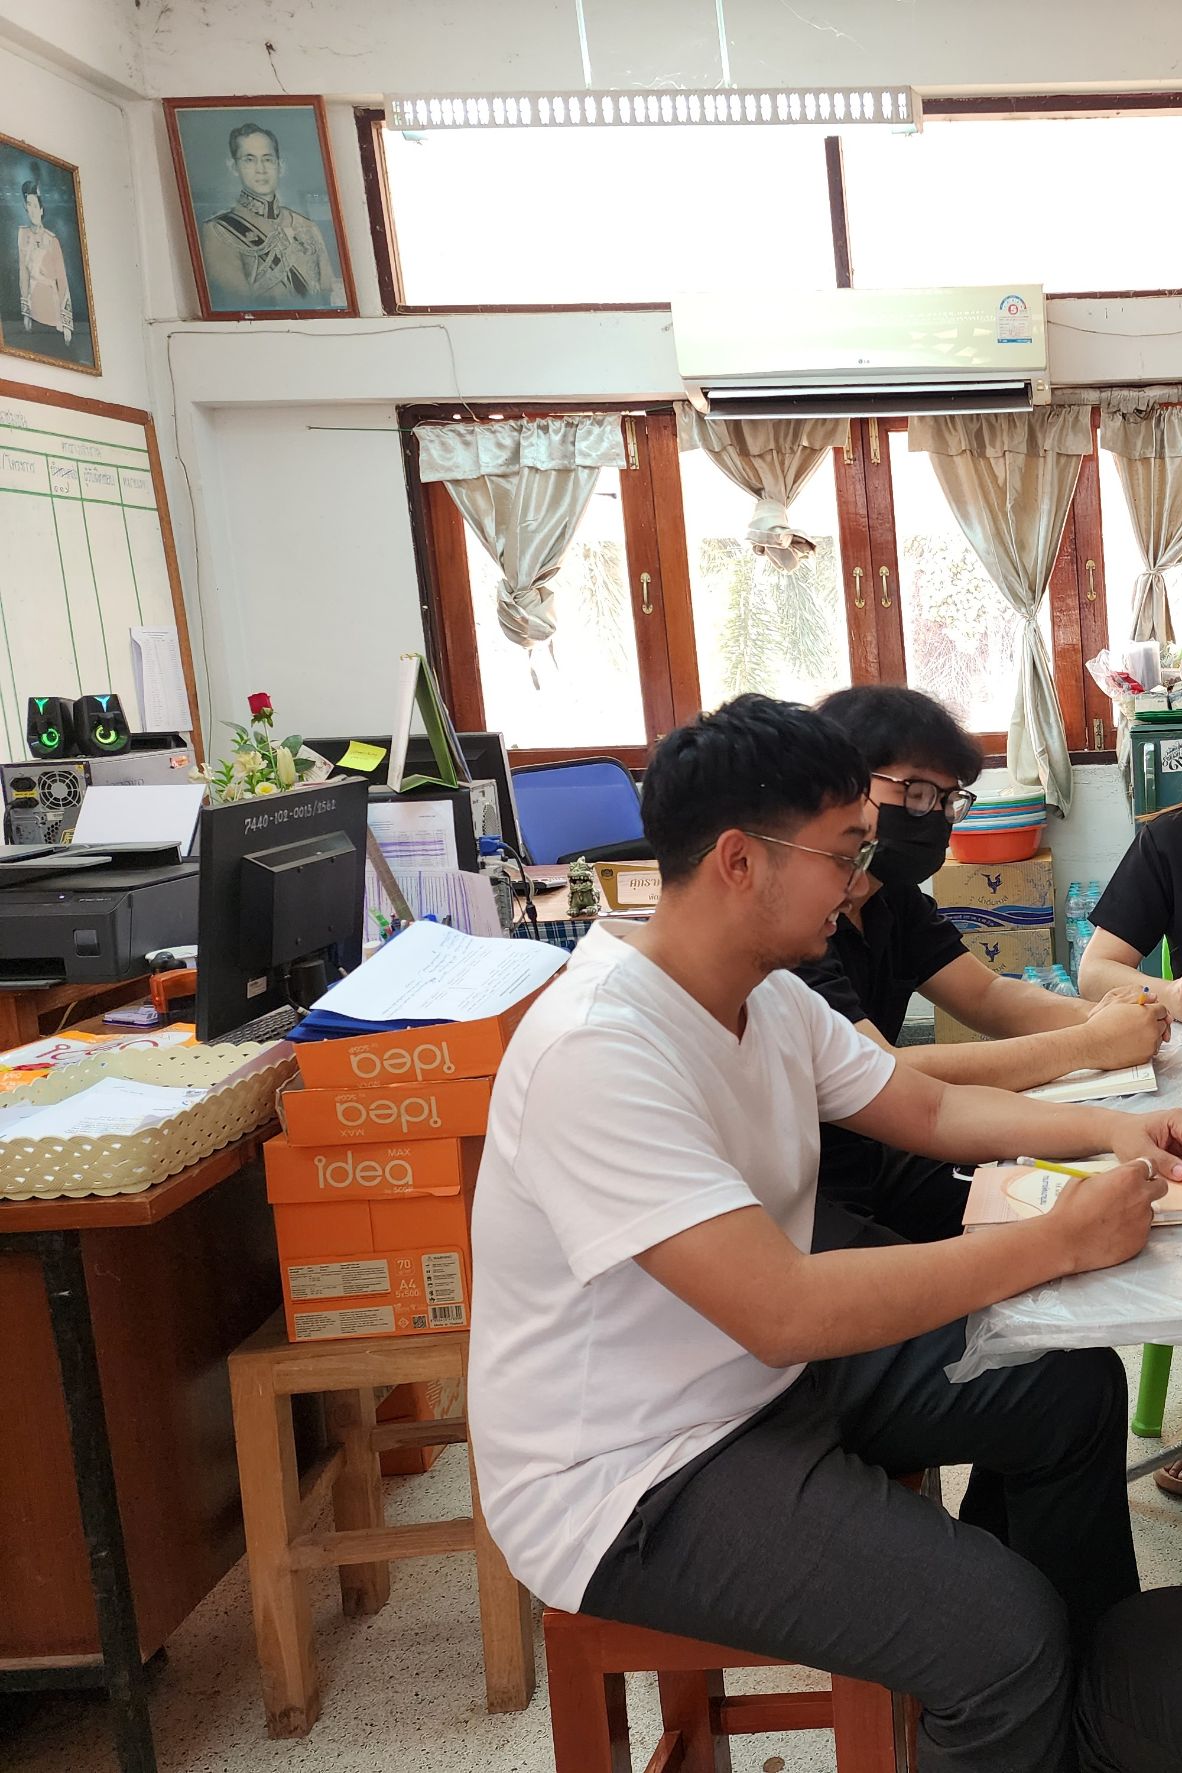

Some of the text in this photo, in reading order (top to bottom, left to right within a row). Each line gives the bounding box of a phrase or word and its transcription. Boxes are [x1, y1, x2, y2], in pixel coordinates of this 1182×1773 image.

[349, 1041, 456, 1082] idea
[335, 1096, 442, 1134] idea
[340, 1128, 365, 1137] MAX
[388, 1148, 412, 1157] MAX
[313, 1151, 414, 1189] idea
[397, 1259, 411, 1270] 70
[400, 1279, 416, 1290] A4
